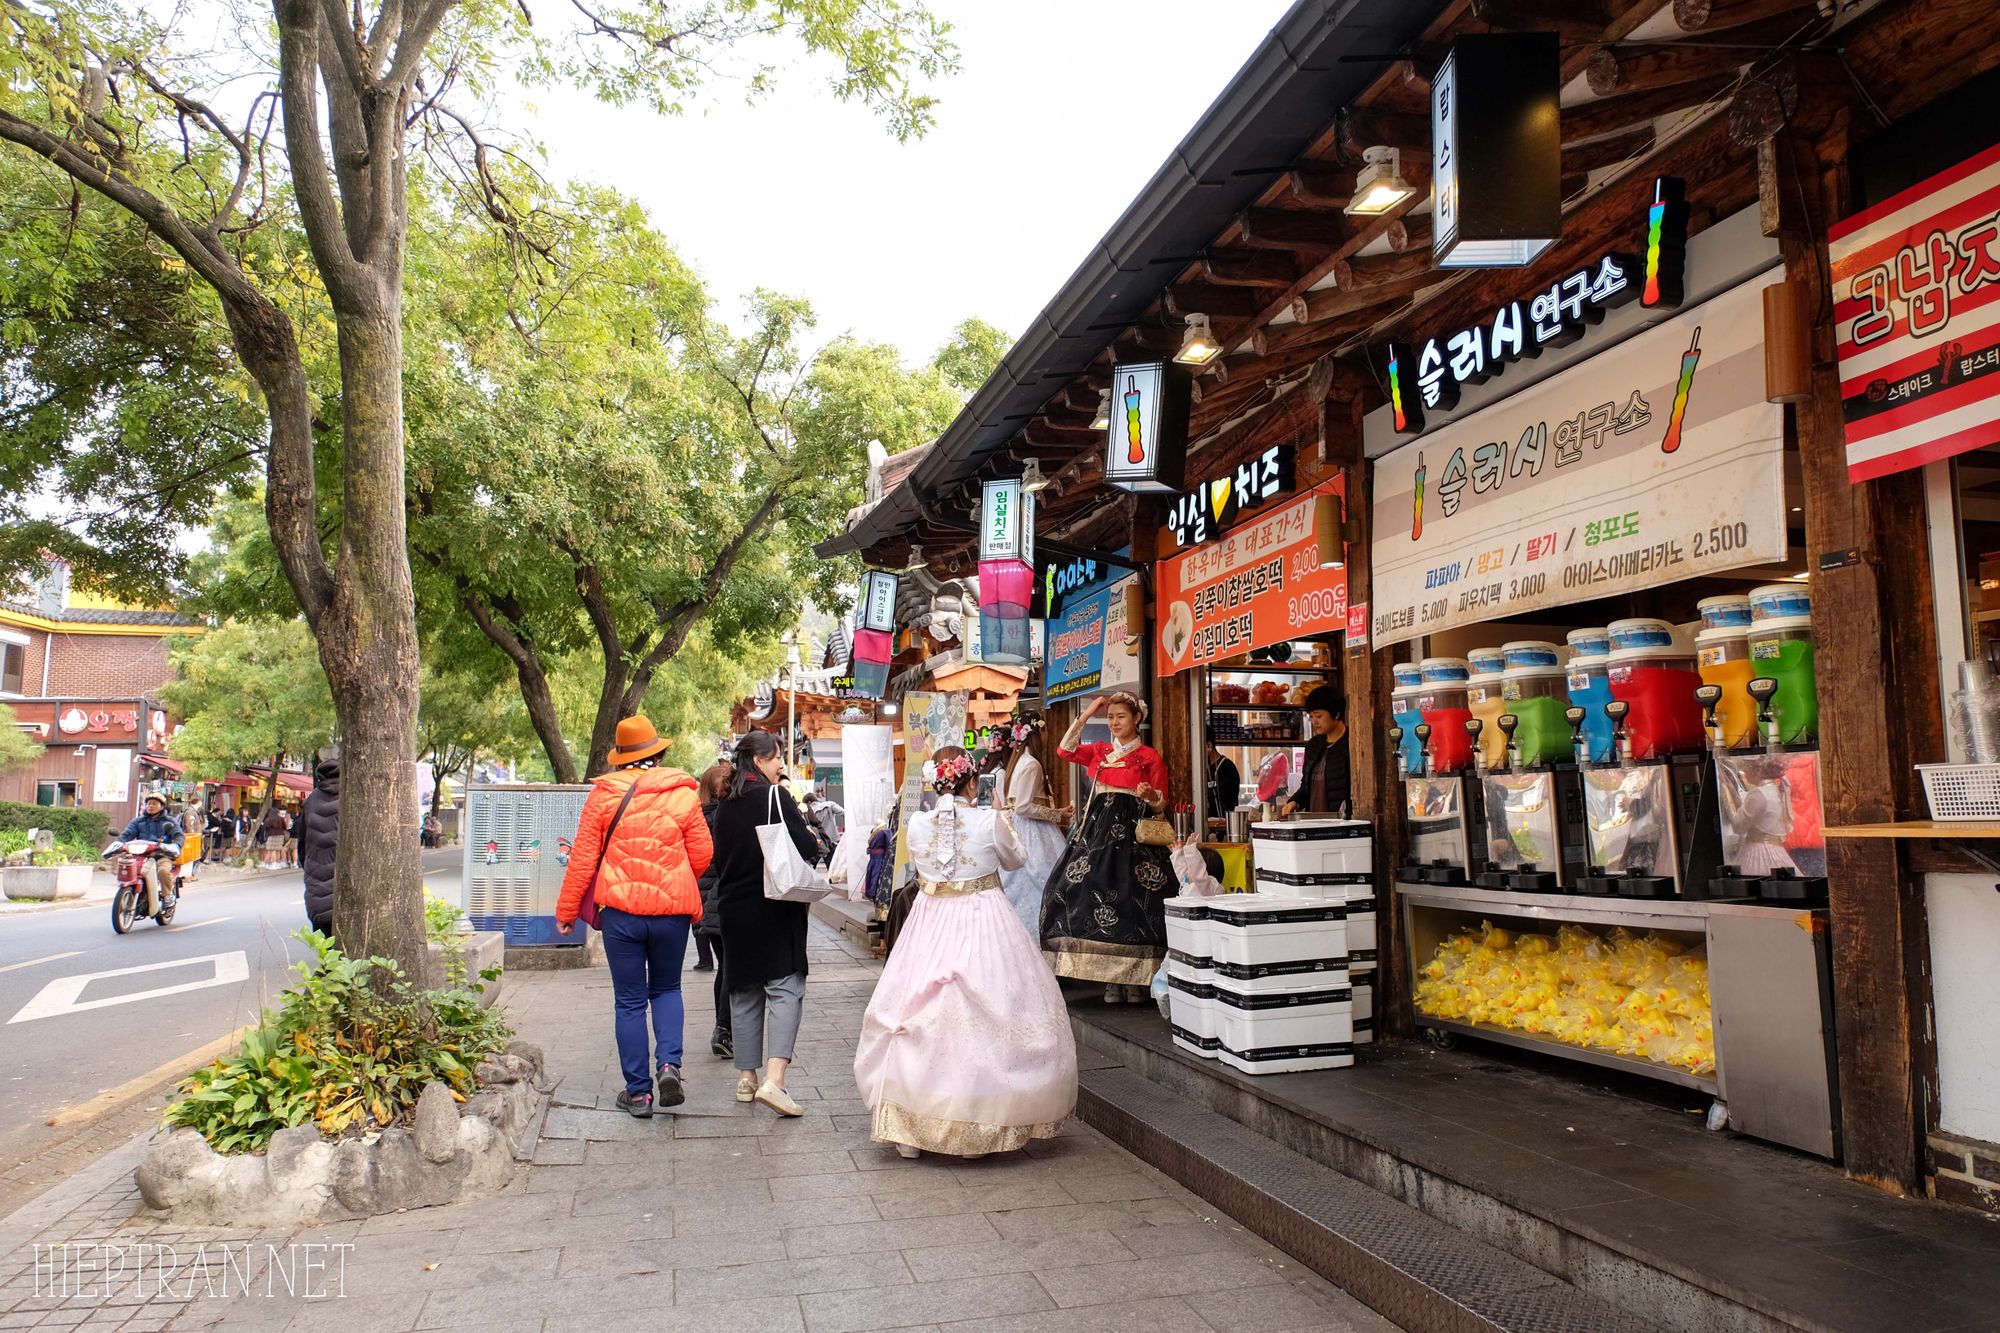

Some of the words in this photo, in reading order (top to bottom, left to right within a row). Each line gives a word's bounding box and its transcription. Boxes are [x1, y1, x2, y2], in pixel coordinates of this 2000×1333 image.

[1418, 302, 1522, 408] 슬러시
[1531, 256, 1628, 343] 연구소
[1888, 374, 1933, 401] 스테이크
[1961, 349, 2000, 376] 랍스터
[1438, 421, 1547, 518] 슬러시
[1554, 390, 1651, 468] 연구소
[993, 491, 1008, 541] 임실치즈
[1168, 482, 1206, 546] 임실
[1234, 445, 1279, 508] 치즈
[989, 542, 1011, 551] 판매점
[1187, 538, 1236, 583] 한옥마을
[1424, 561, 1461, 590] 파파야
[1477, 547, 1504, 572] 망고
[1526, 532, 1557, 562] 딸기
[1584, 511, 1639, 546] 청포도
[1193, 556, 1284, 621] 길쭉이찹쌀호떡
[1458, 582, 1502, 612] 파우치팩
[1563, 540, 1684, 588] 아이스아메리카노
[1193, 611, 1253, 660] 인절미호떡
